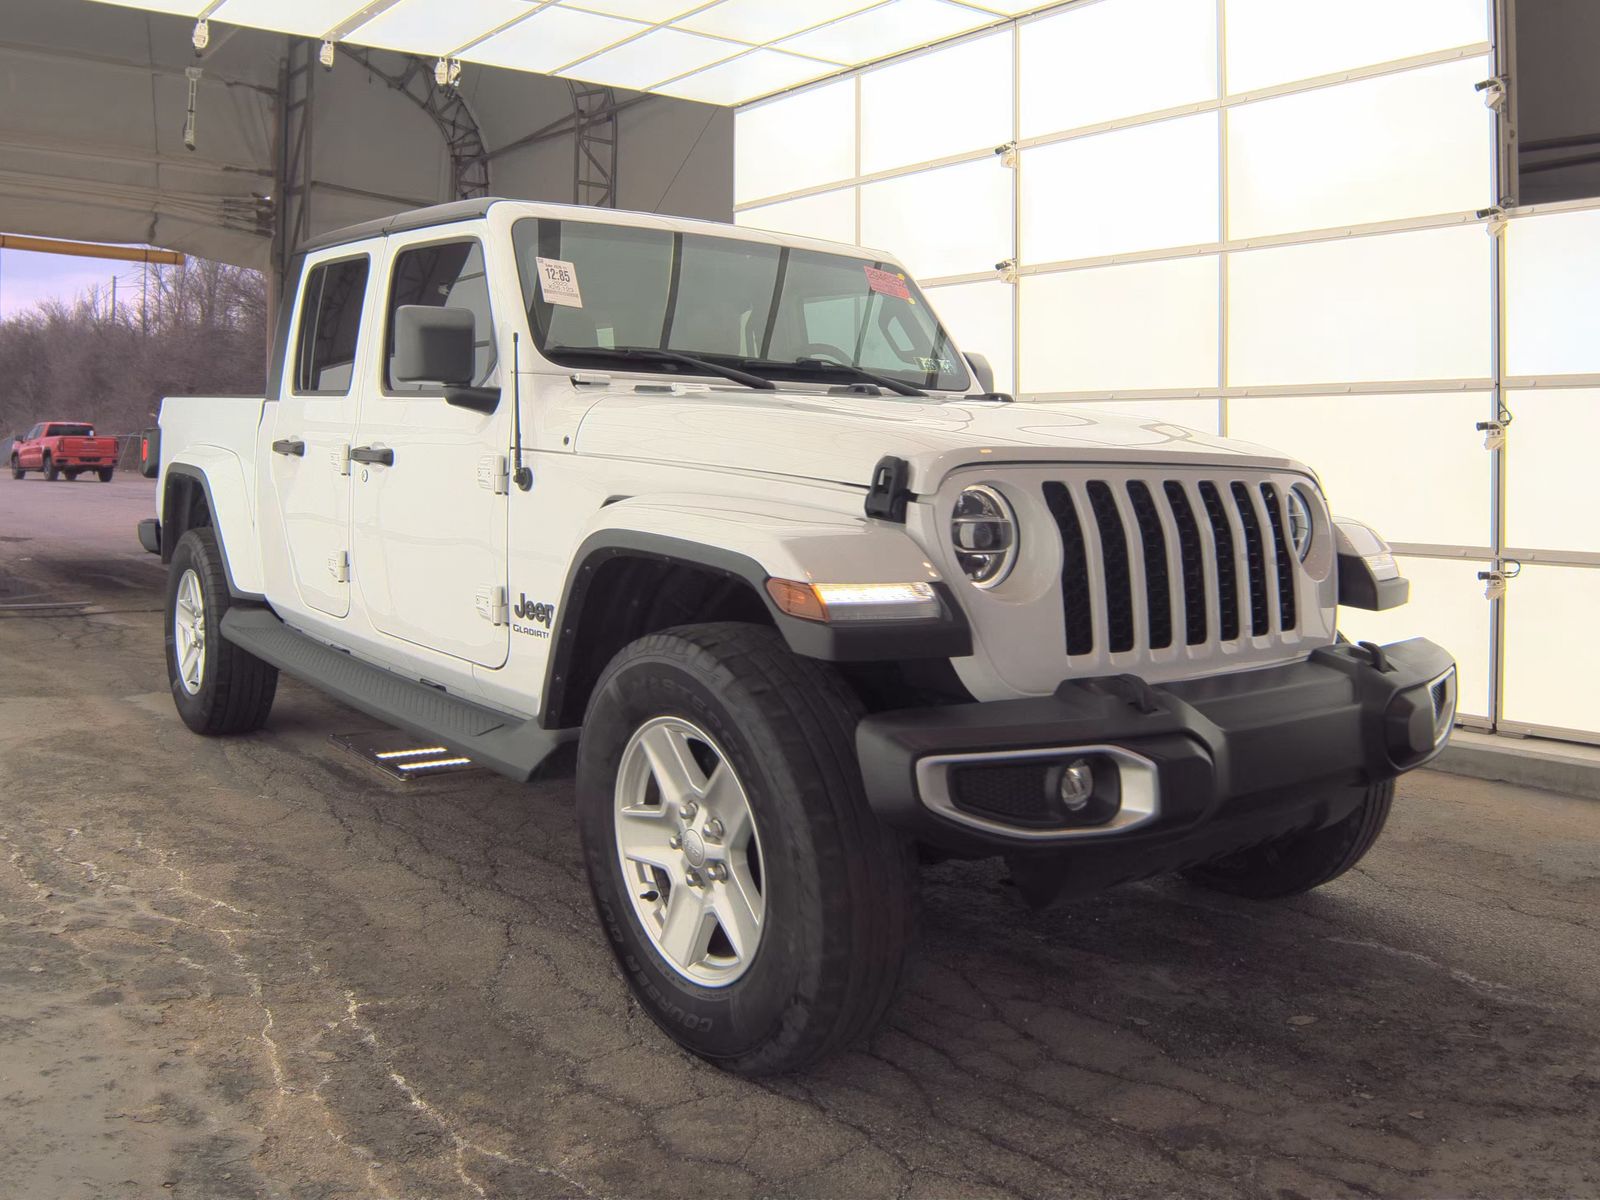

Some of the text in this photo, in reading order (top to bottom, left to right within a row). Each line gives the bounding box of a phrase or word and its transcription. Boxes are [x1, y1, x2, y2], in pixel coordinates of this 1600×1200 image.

[545, 267, 570, 282] 12:85
[514, 592, 555, 629] Jeep
[513, 624, 549, 639] GLADIAT
